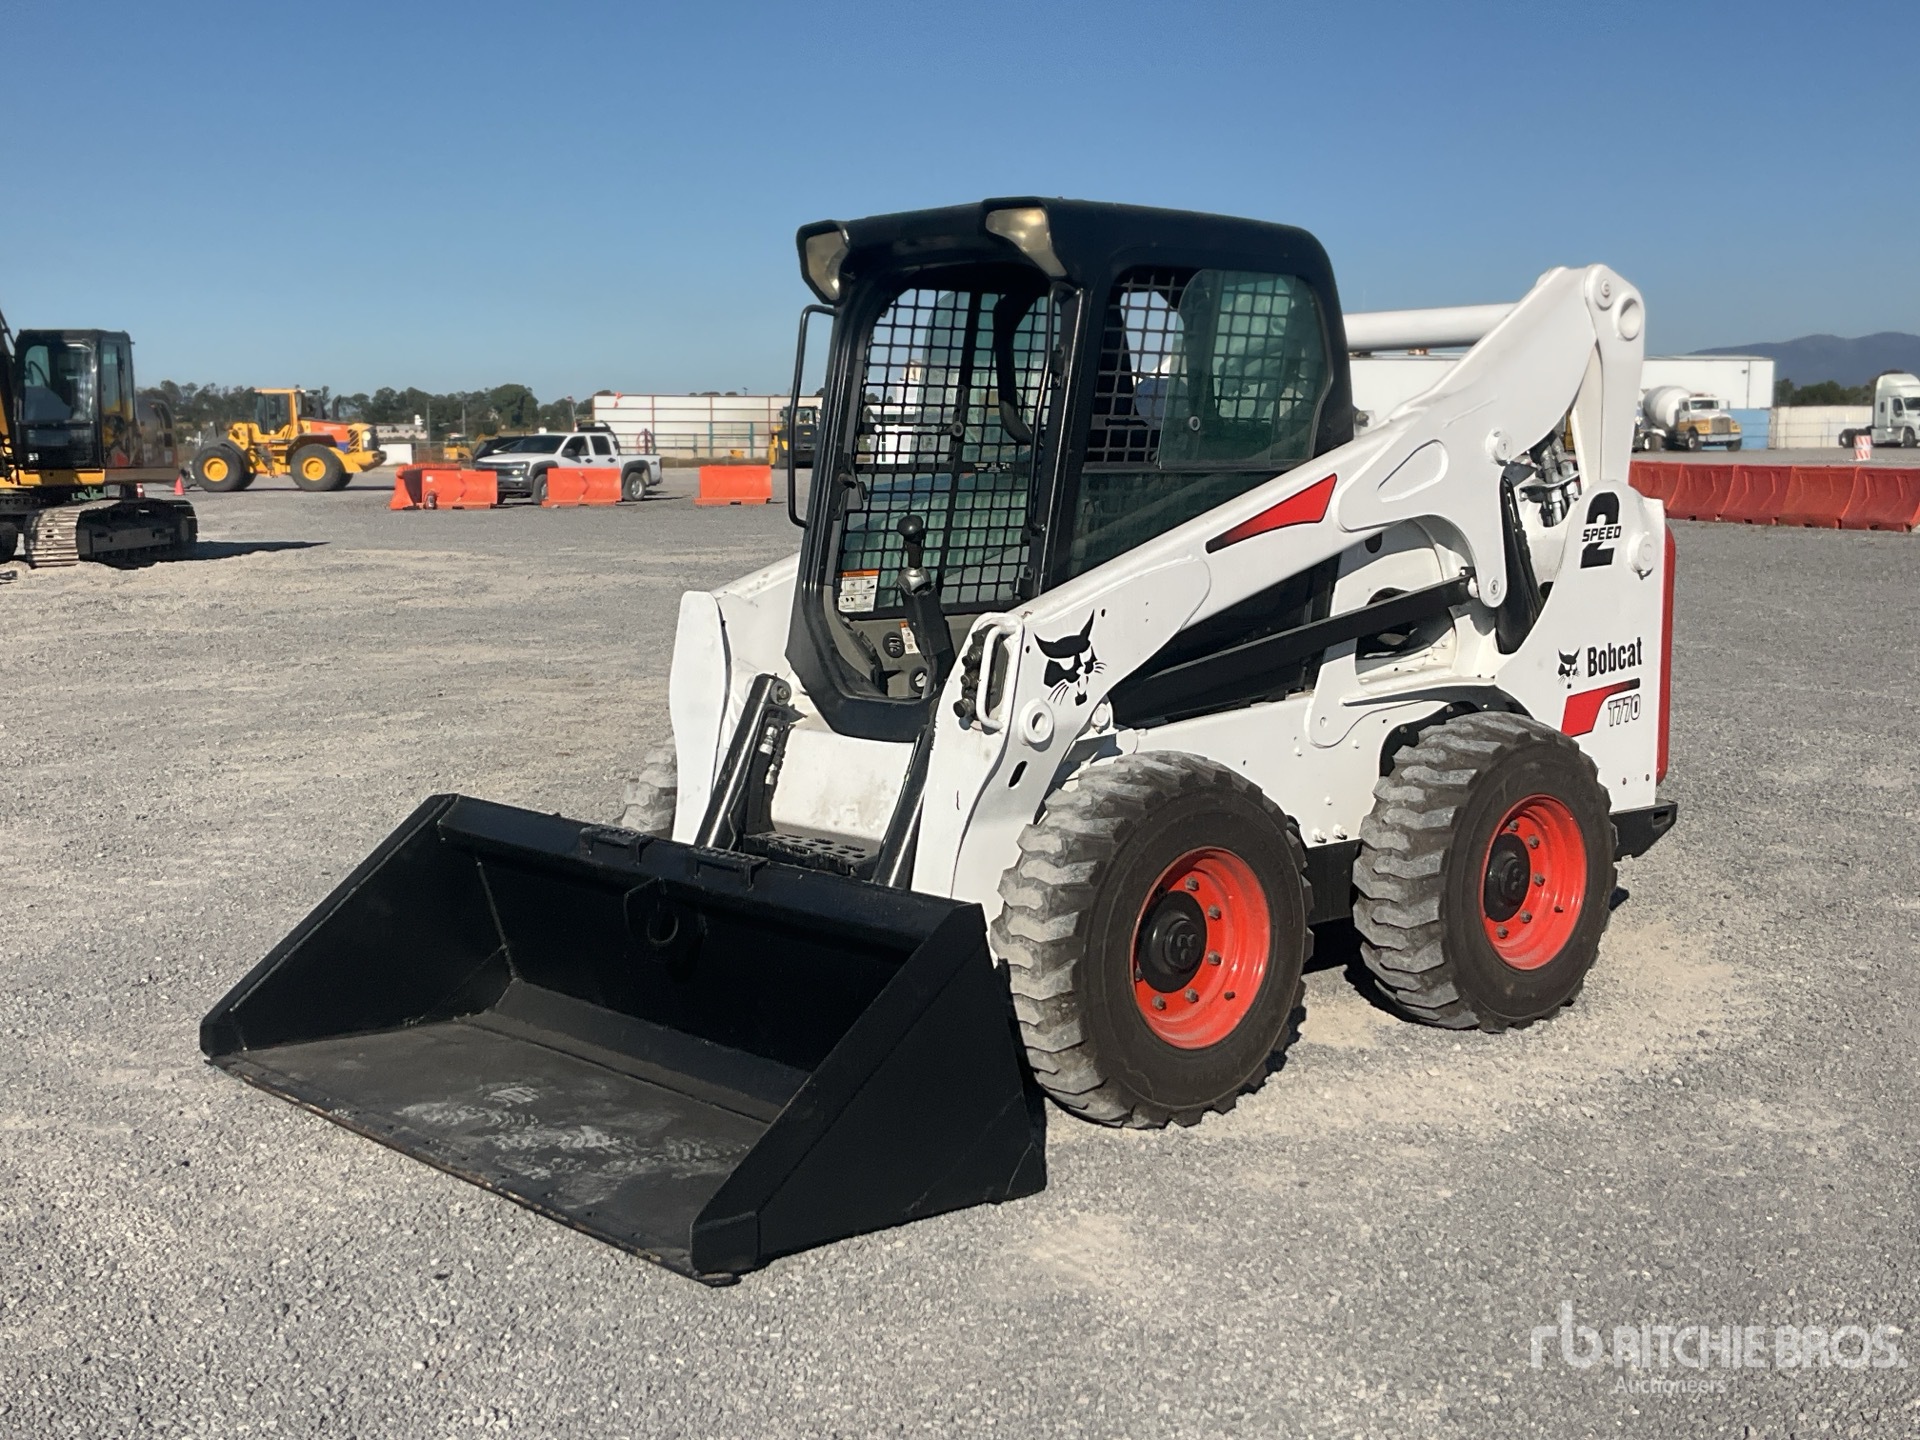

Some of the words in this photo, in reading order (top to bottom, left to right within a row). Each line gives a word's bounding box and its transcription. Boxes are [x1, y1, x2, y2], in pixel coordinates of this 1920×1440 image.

[1580, 492, 1620, 569] 2
[1582, 526, 1622, 542] SPEED
[1587, 636, 1642, 678] Bobcat
[1608, 693, 1641, 727] T770
